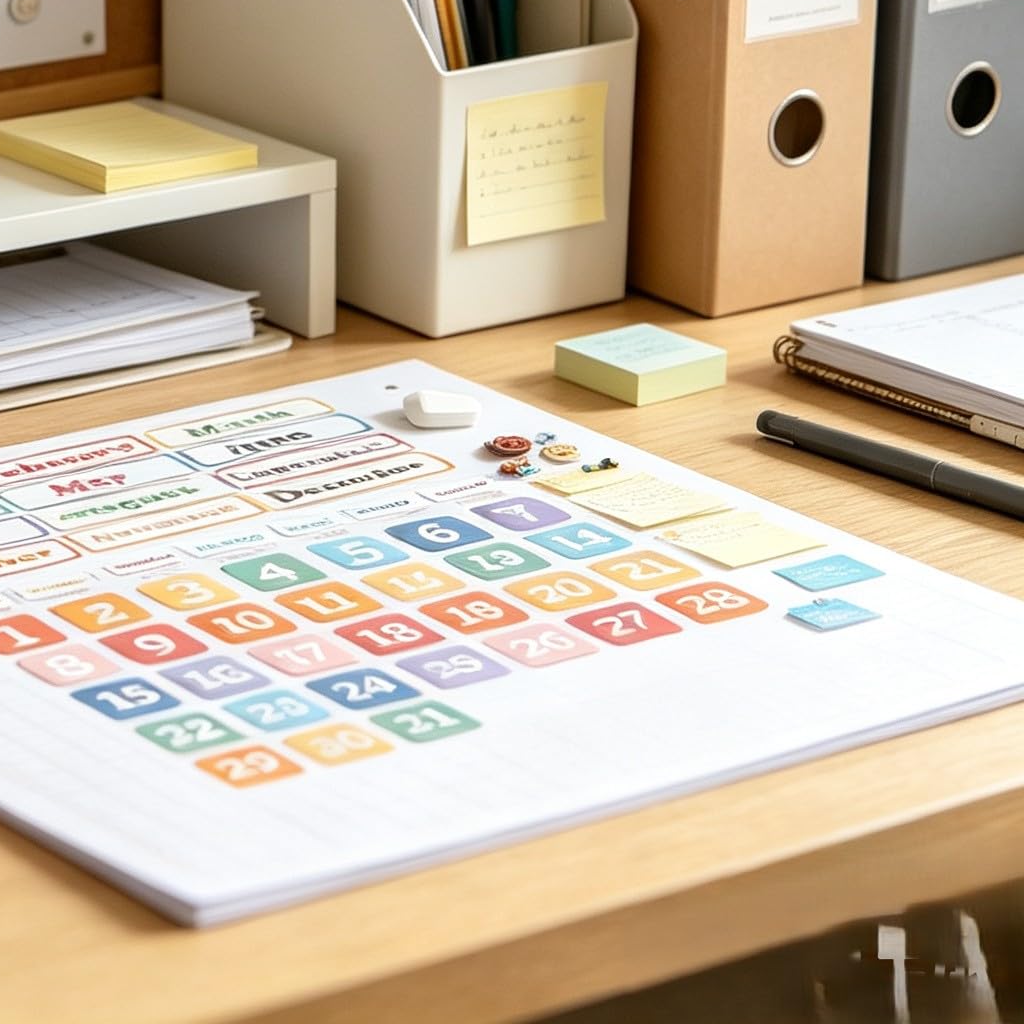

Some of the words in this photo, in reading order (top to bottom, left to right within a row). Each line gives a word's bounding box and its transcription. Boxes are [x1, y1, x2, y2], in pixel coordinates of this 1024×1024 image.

[84, 603, 128, 624] 2
[168, 579, 215, 604] 3
[260, 563, 298, 580] 4
[338, 541, 384, 565] 5
[418, 523, 459, 543] 6
[46, 655, 95, 680] 8
[134, 634, 176, 656] 9
[213, 611, 274, 634] 10
[296, 592, 357, 614] 11
[97, 685, 160, 710] 15
[274, 642, 326, 666] 17
[357, 621, 422, 647] 18
[528, 578, 590, 602] 20
[611, 557, 680, 581] 21
[332, 676, 396, 701] 24
[593, 610, 647, 636] 27
[677, 589, 749, 614] 28
